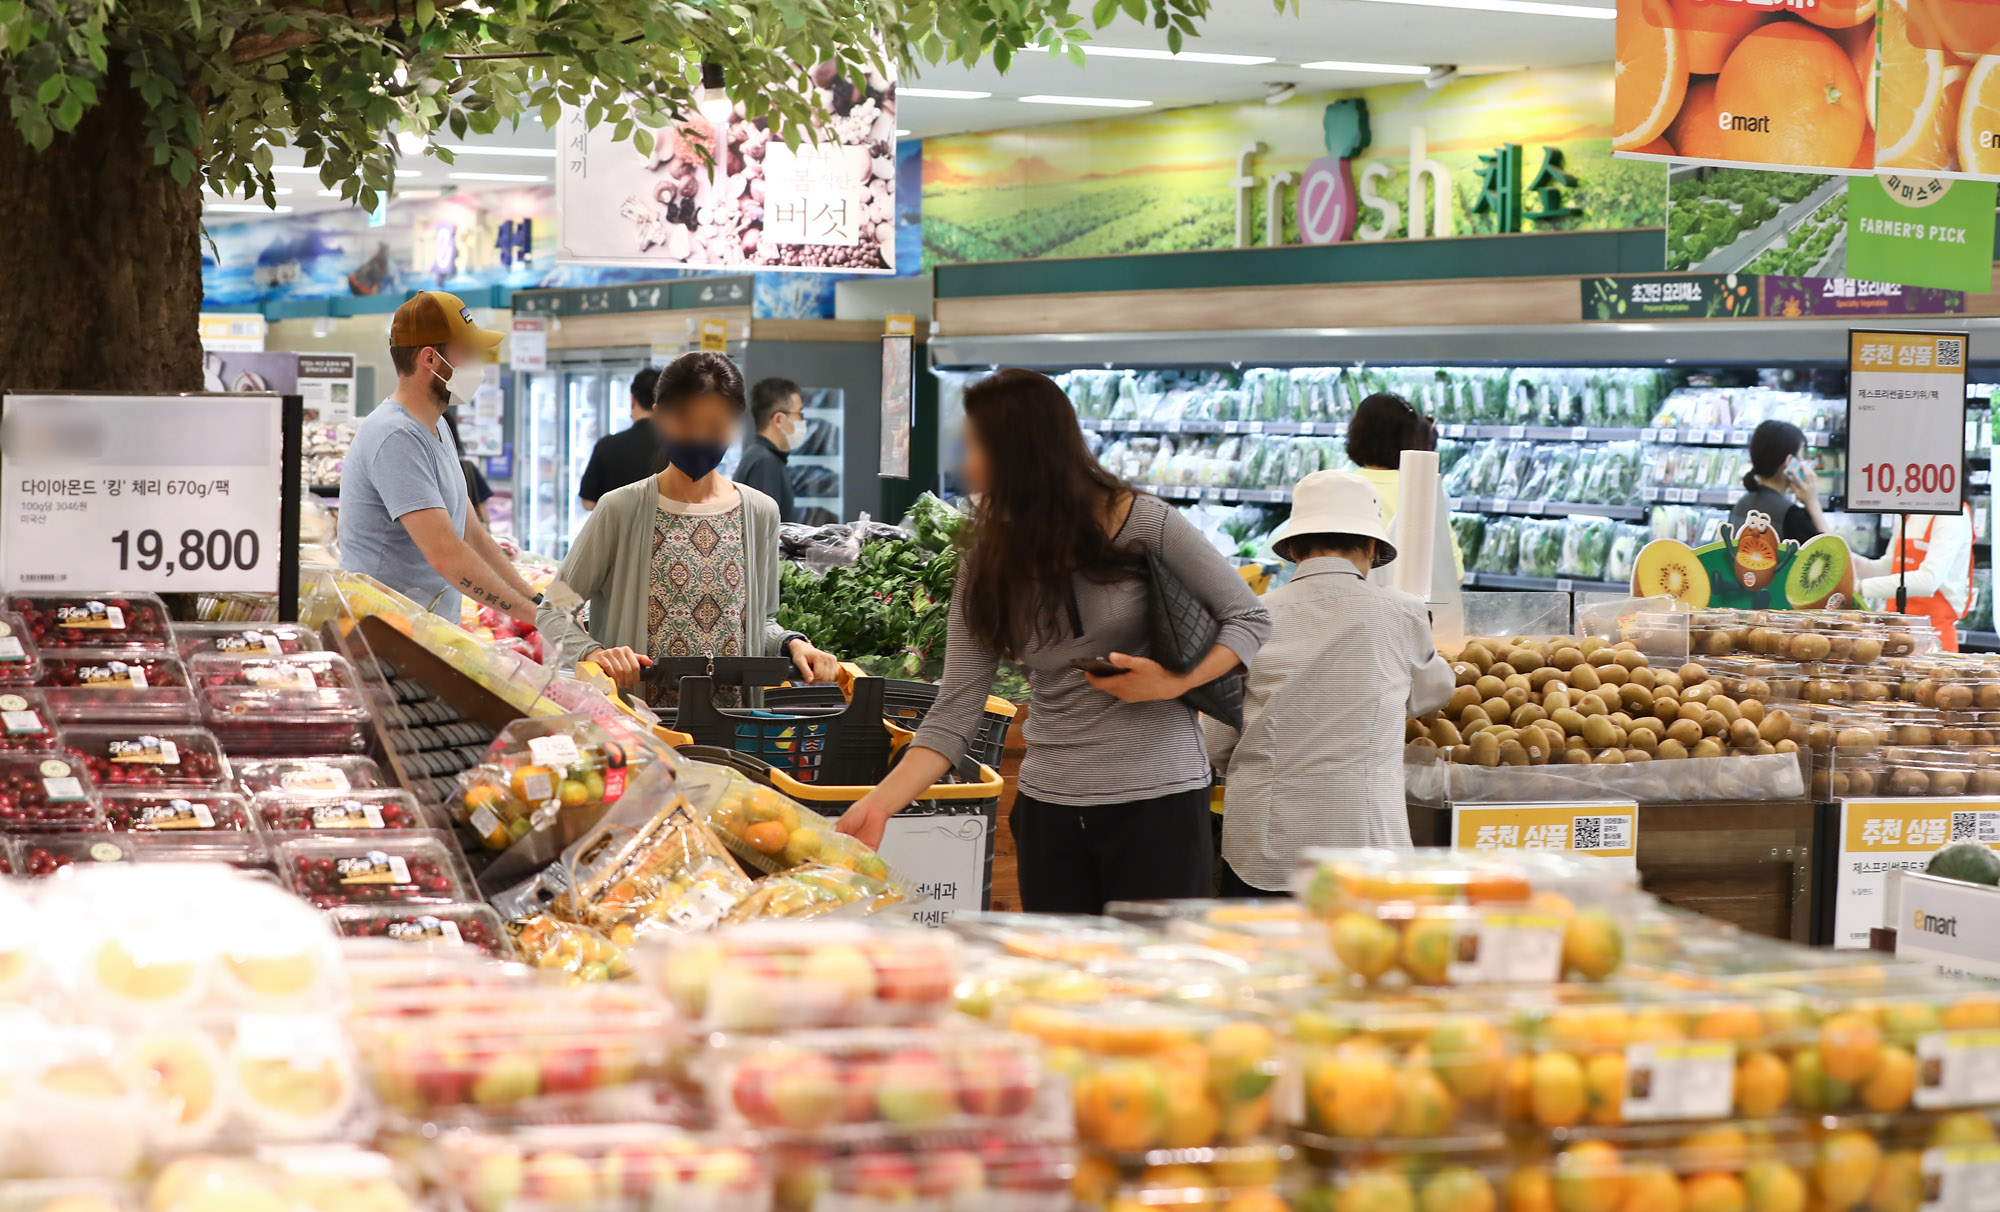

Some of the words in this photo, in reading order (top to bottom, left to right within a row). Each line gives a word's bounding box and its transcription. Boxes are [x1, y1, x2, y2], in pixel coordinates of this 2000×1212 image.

[1718, 111, 1770, 133] emart
[569, 97, 588, 179] 시세끼
[1229, 126, 1452, 248] fresh
[1472, 142, 1583, 233] 채소
[775, 197, 847, 238] 버섯
[1859, 217, 1925, 240] FARMER'S
[1929, 225, 1967, 244] PICK
[1859, 344, 1894, 366] 추천
[1897, 345, 1934, 367] 상품
[21, 479, 97, 496] 다이아몬드
[103, 479, 127, 496] '킹'
[131, 479, 161, 496] 체리
[167, 479, 230, 498] 670g/팩
[1861, 463, 1956, 497] 10,800
[20, 514, 47, 524] 미국산
[111, 529, 260, 577] 19,800
[1475, 825, 1520, 853] 추천
[1524, 824, 1569, 852] 상품
[1861, 819, 1903, 846] 추천
[1906, 818, 1947, 845] 상품
[1913, 909, 1957, 937] emart
